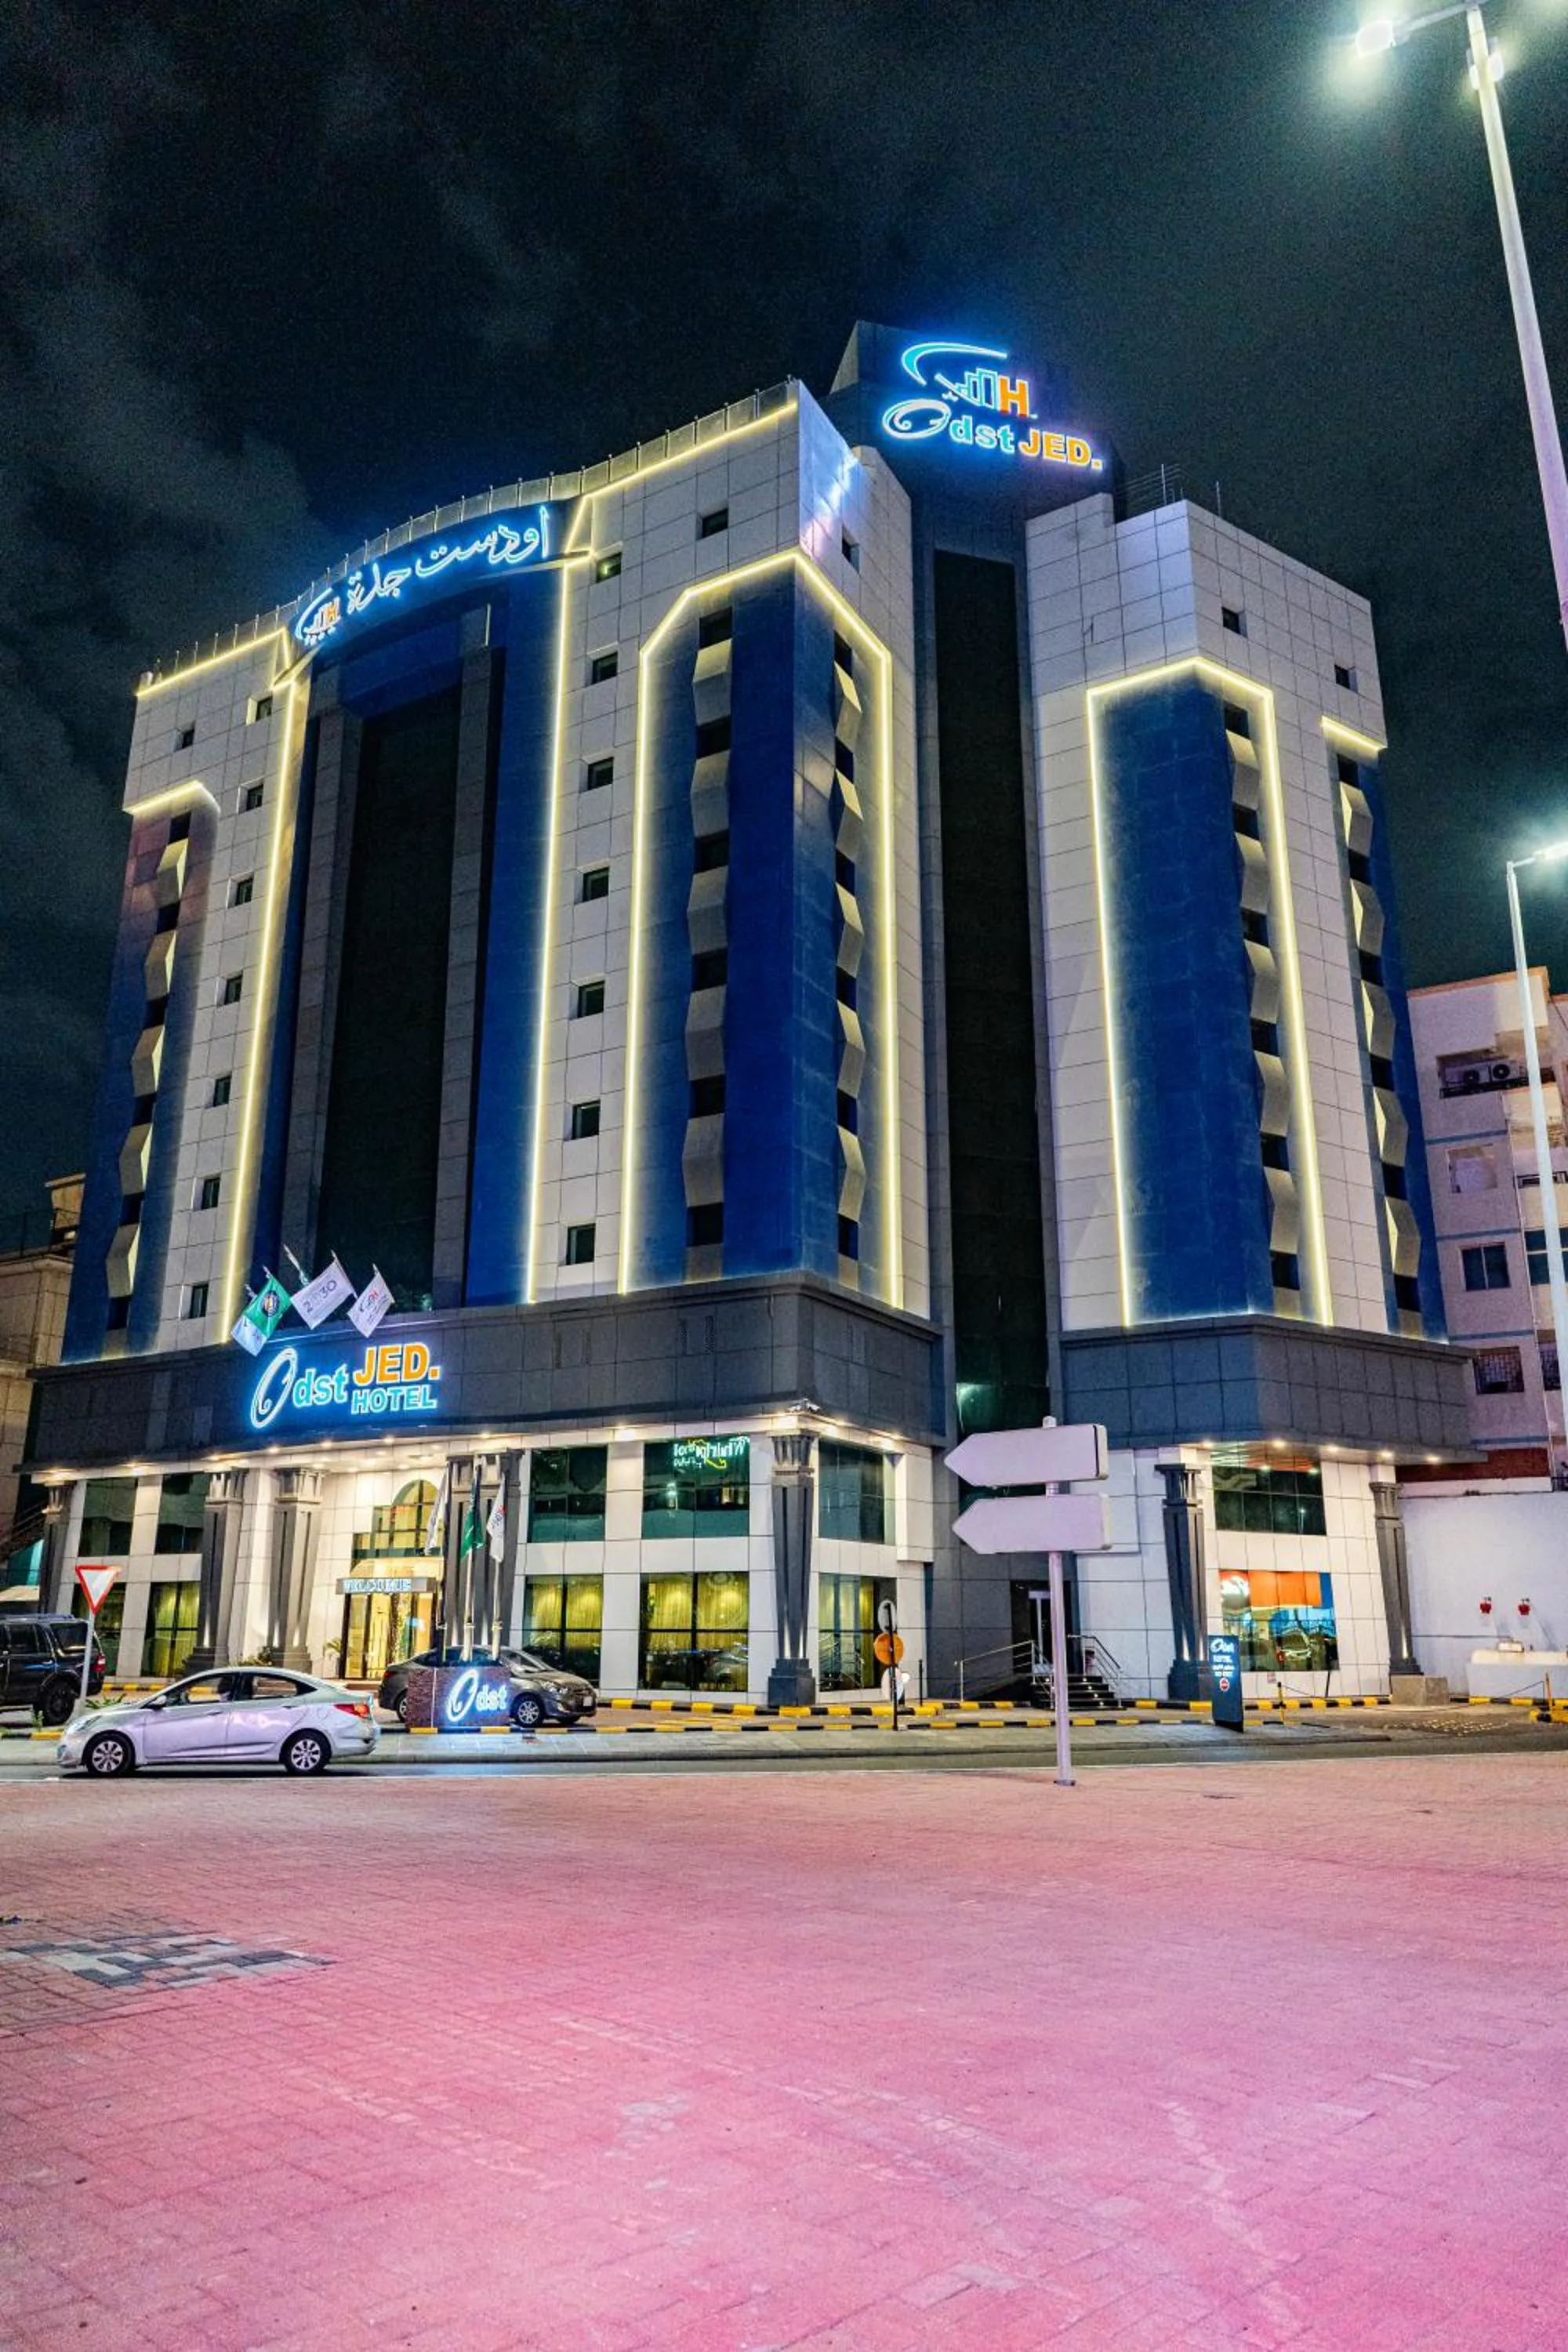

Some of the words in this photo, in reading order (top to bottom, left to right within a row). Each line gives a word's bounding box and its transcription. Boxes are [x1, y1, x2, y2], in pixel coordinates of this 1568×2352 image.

[882, 398, 1015, 454] Odst
[1018, 427, 1104, 471] JED.
[251, 1347, 349, 1428] Odst
[353, 1341, 441, 1387] JED.
[351, 1385, 437, 1414] HOTEL
[446, 1668, 507, 1722] Odst
